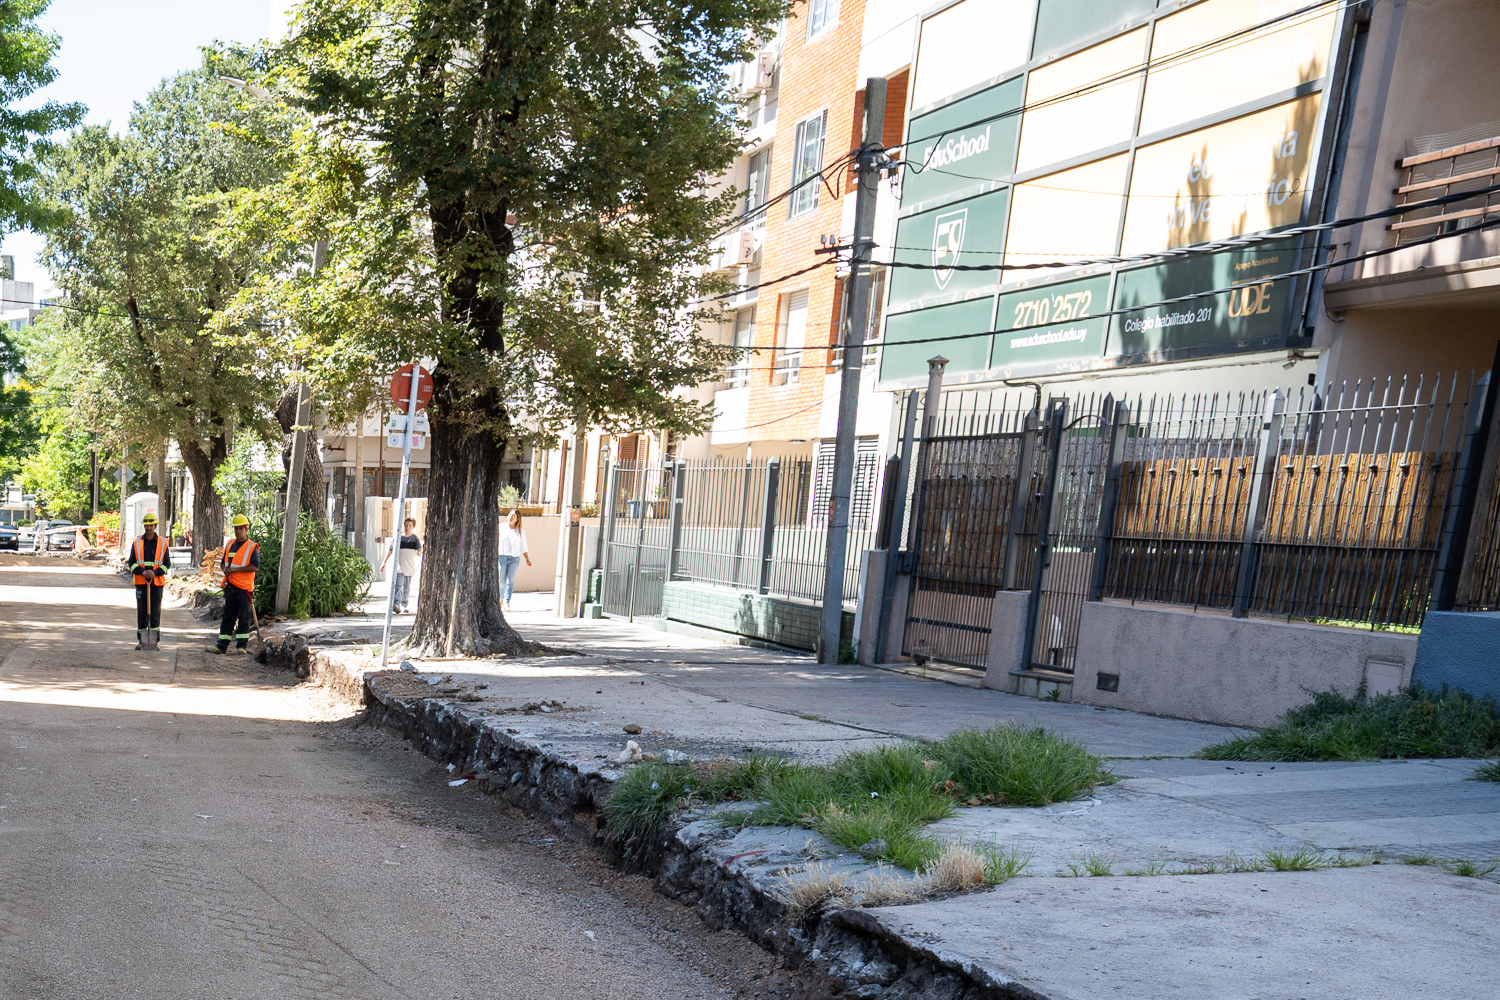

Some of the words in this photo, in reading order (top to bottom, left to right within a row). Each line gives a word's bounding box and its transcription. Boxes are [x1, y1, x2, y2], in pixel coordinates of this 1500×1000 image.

[922, 125, 991, 172] EduSchool
[1234, 261, 1251, 271] Apoyo
[1012, 297, 1050, 329] 2710
[1050, 290, 1092, 323] 2572
[1228, 281, 1274, 318] UDE
[1124, 316, 1154, 333] Colegio
[1154, 310, 1195, 328] habilitado
[1195, 307, 1212, 322] 201
[1010, 327, 1087, 349] www.eduschool.edu.uy
